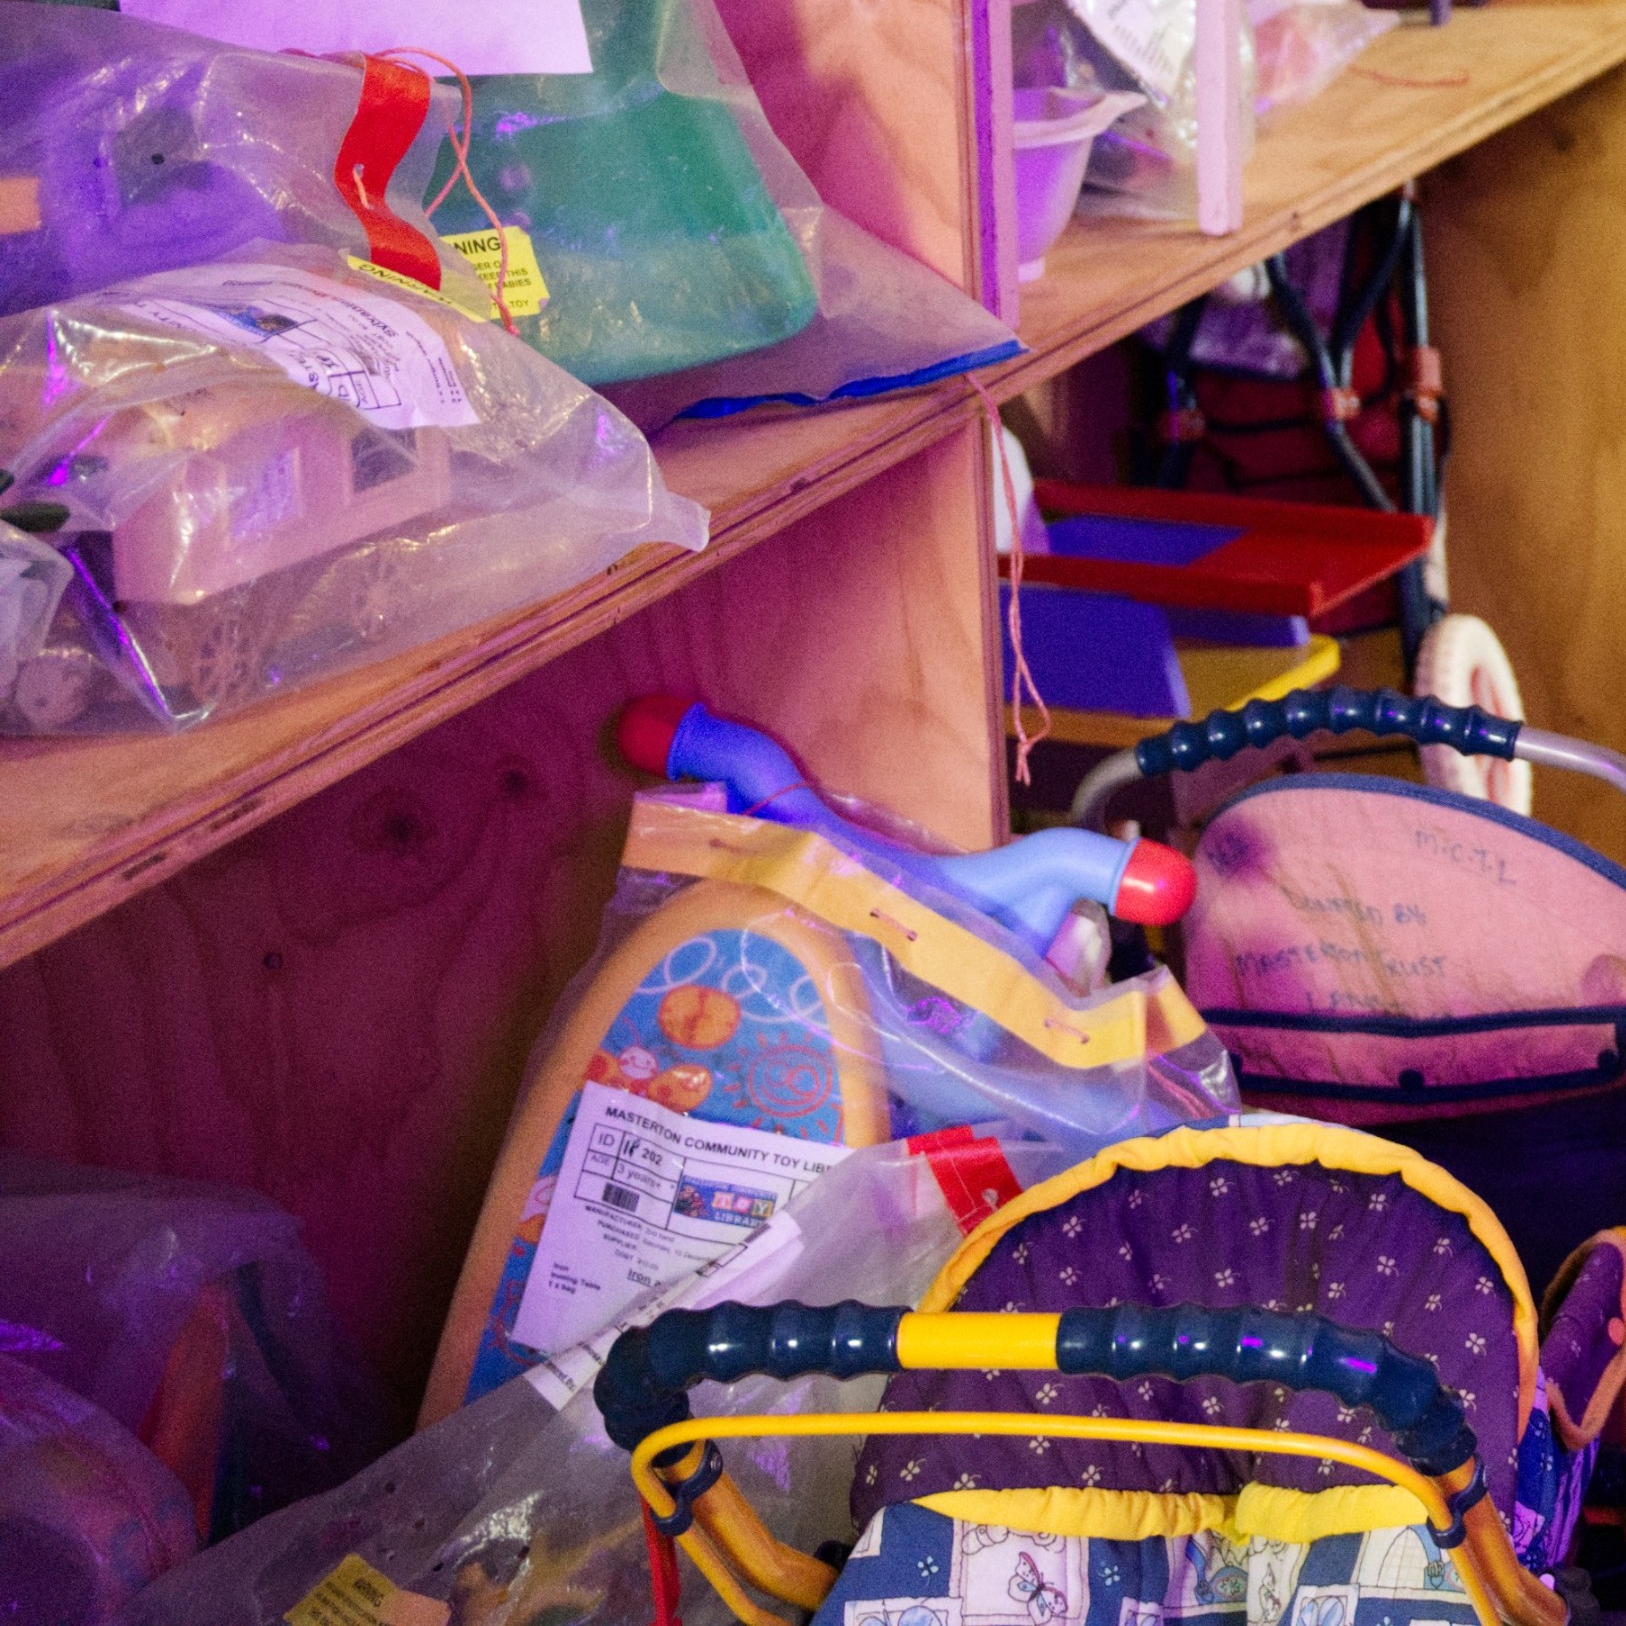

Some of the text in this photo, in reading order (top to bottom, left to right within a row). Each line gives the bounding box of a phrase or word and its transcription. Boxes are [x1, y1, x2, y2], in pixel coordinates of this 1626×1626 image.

[509, 299, 530, 309] TOY
[605, 1105, 801, 1169] MASTERTON COMMUNITY TOY
[598, 1132, 664, 1167] ID 202
[590, 1153, 662, 1190] AGE years+
[585, 1205, 643, 1231] MANUFACTURER
[597, 1220, 640, 1242] PURCHASED
[603, 1233, 638, 1251] SUPPLIER
[627, 1267, 652, 1286] Iron
